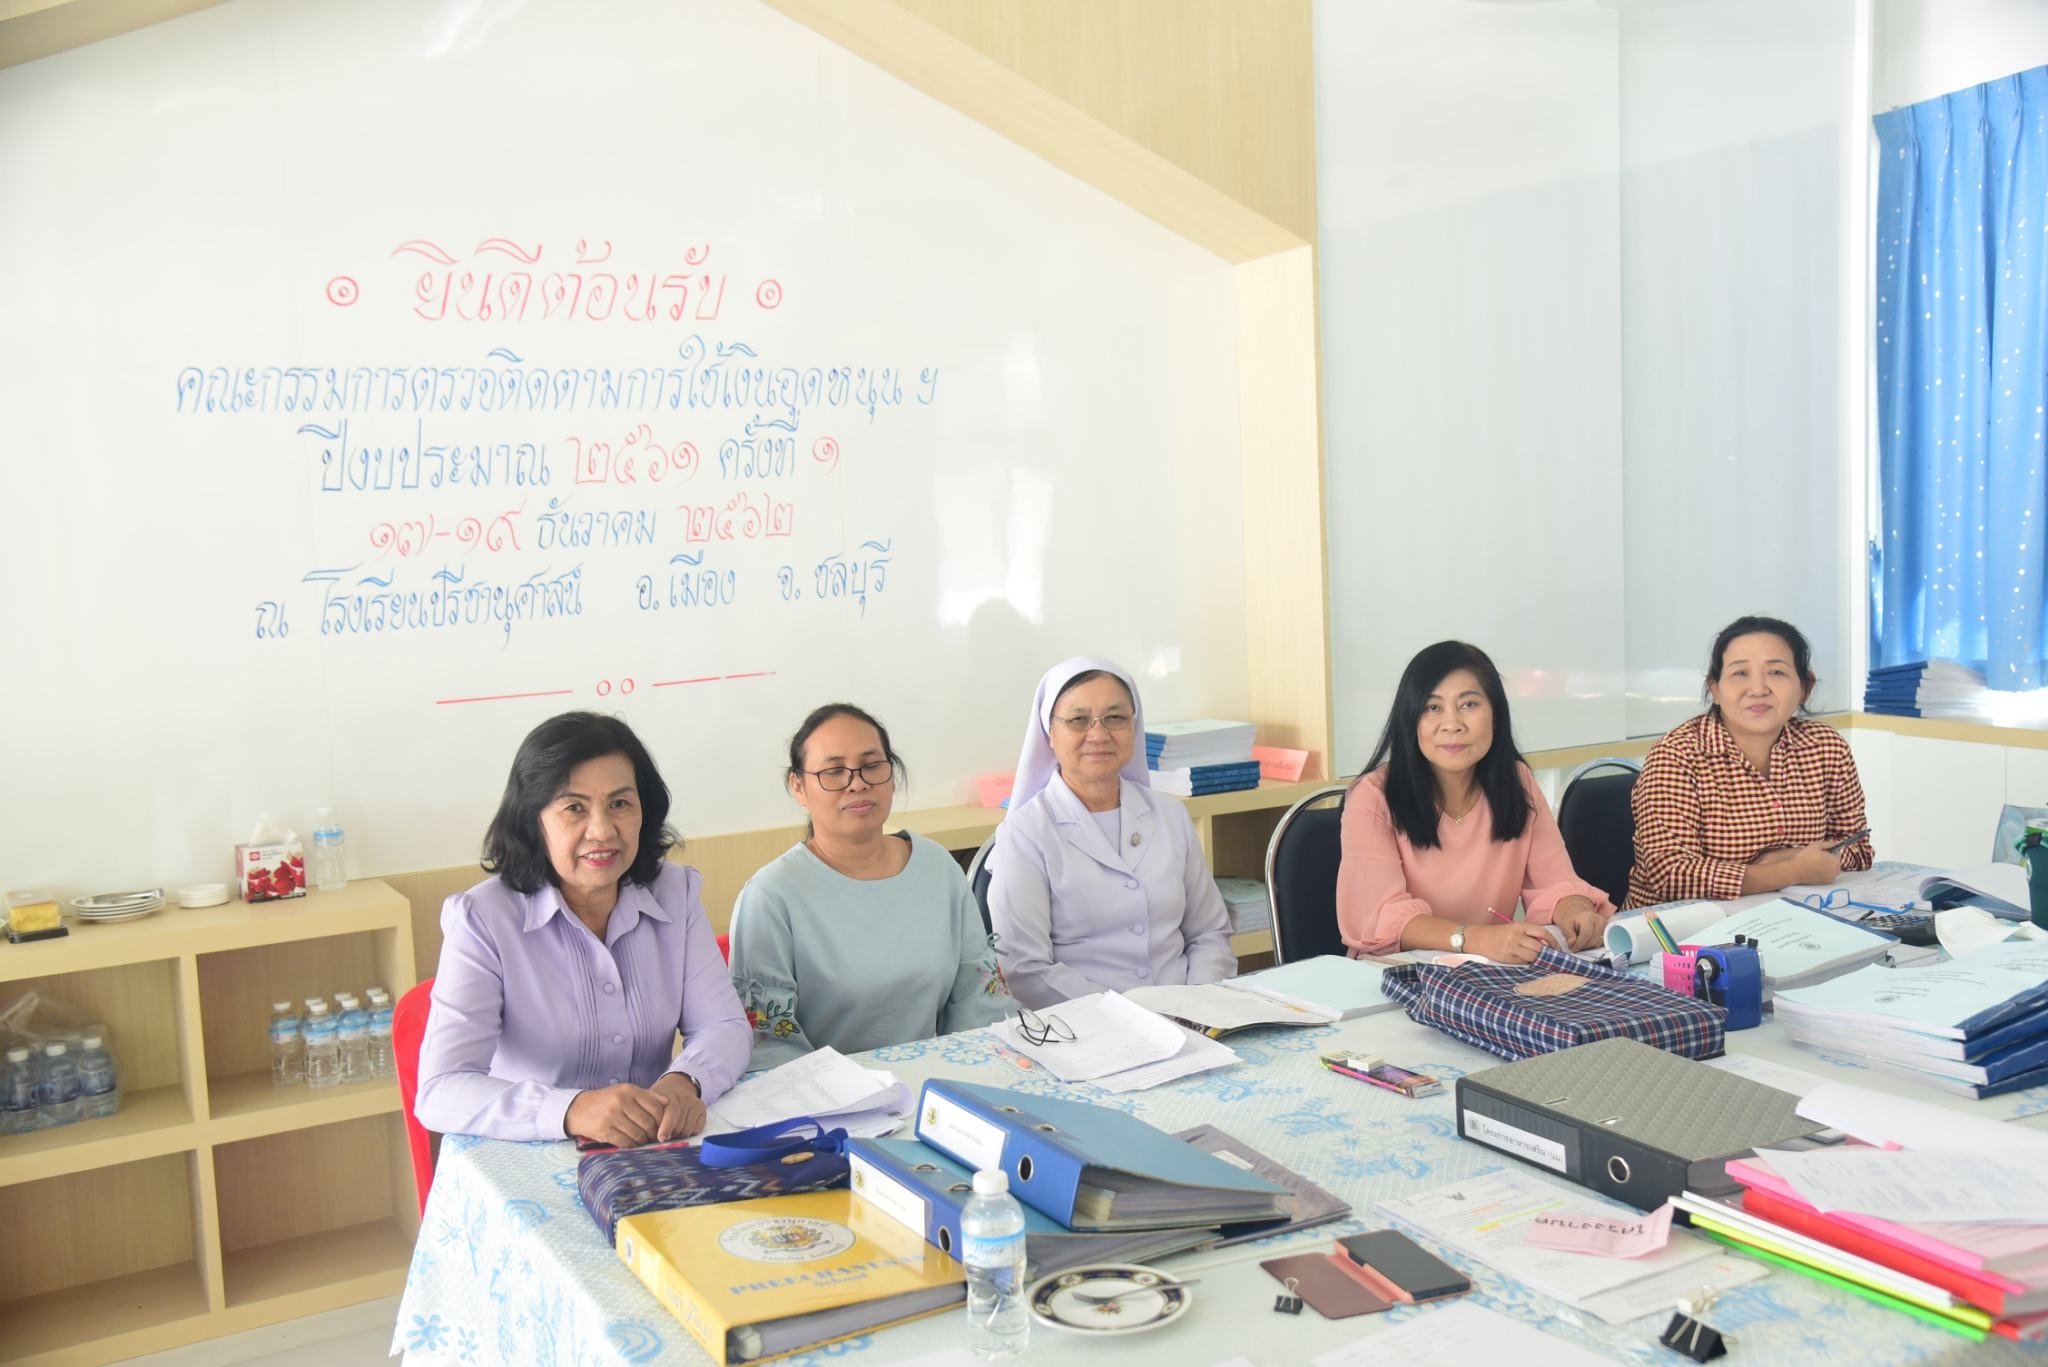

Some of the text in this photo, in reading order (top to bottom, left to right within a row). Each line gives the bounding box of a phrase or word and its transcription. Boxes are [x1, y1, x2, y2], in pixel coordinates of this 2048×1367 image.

[389, 238, 727, 323] ยินดีต้อนรับ
[297, 417, 551, 492] ปีงบประมาณ
[566, 424, 701, 488] ๒๕๖๑
[811, 435, 841, 476] ๑
[536, 495, 657, 550] ธันวาคม
[678, 491, 795, 545] ๒๕๖๒
[254, 599, 290, 640] ณ
[301, 561, 585, 653] โรงเรียนปรีชานุศาสน์
